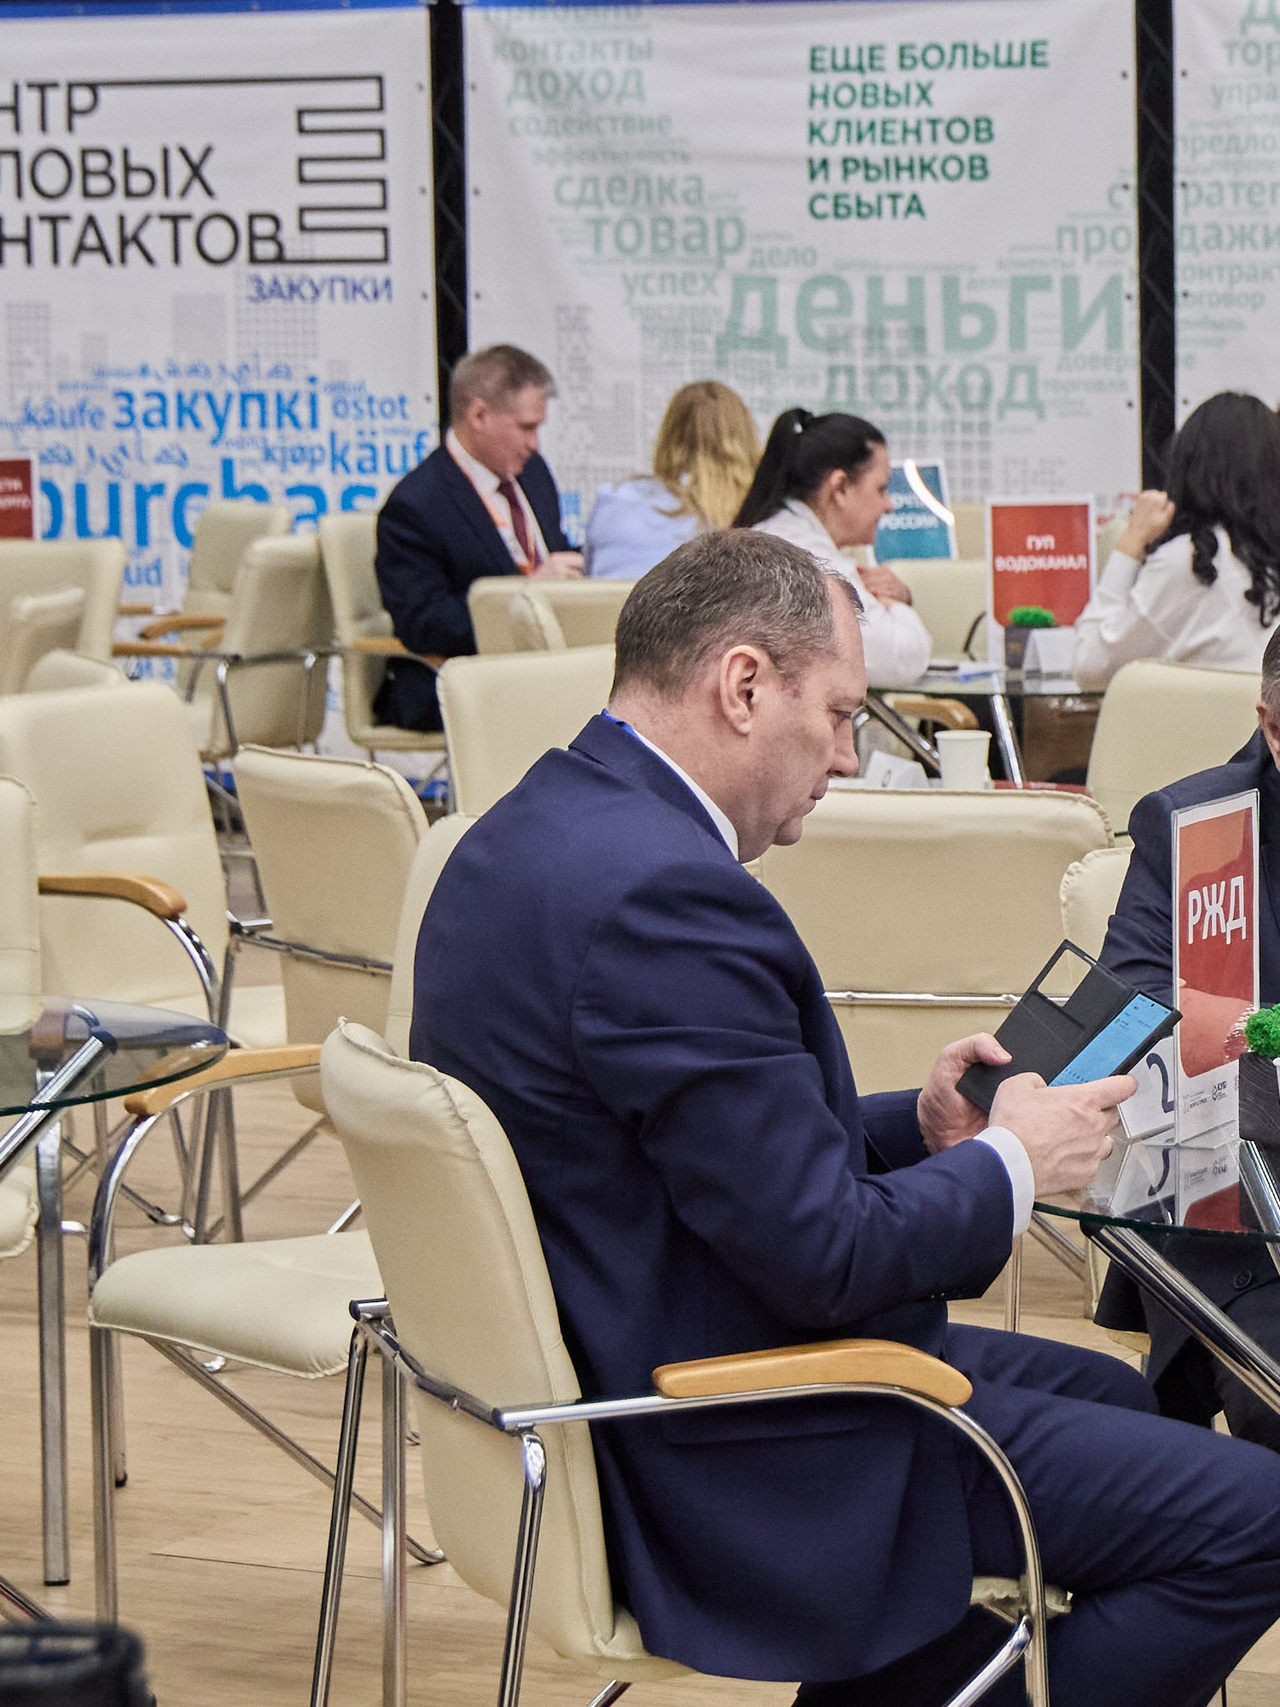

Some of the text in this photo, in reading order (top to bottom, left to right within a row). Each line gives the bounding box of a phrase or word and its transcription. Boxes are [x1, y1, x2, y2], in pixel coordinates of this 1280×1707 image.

[808, 38, 1049, 76] ЕЩЕ БОЛЬШЕ
[508, 68, 647, 104] доход
[808, 80, 934, 110] НОВЫХ
[807, 115, 995, 146] КЛИЕНТОВ
[807, 153, 990, 183] И РЫНКОВ
[554, 172, 704, 212] сделка
[807, 191, 926, 221] СБЫТА
[0, 212, 286, 267] НТАКТОВ
[585, 214, 745, 271] товар
[1055, 224, 1132, 262] про
[248, 274, 393, 304] ЗАКУПКИ
[714, 273, 1125, 369] деньги
[113, 375, 319, 447] закупкі
[331, 394, 409, 422] ostot
[819, 362, 1046, 422] доход
[995, 554, 1087, 574] ВОДОКАНАЛ
[1187, 873, 1247, 945] РЖД
[1146, 1052, 1175, 1114] 2
